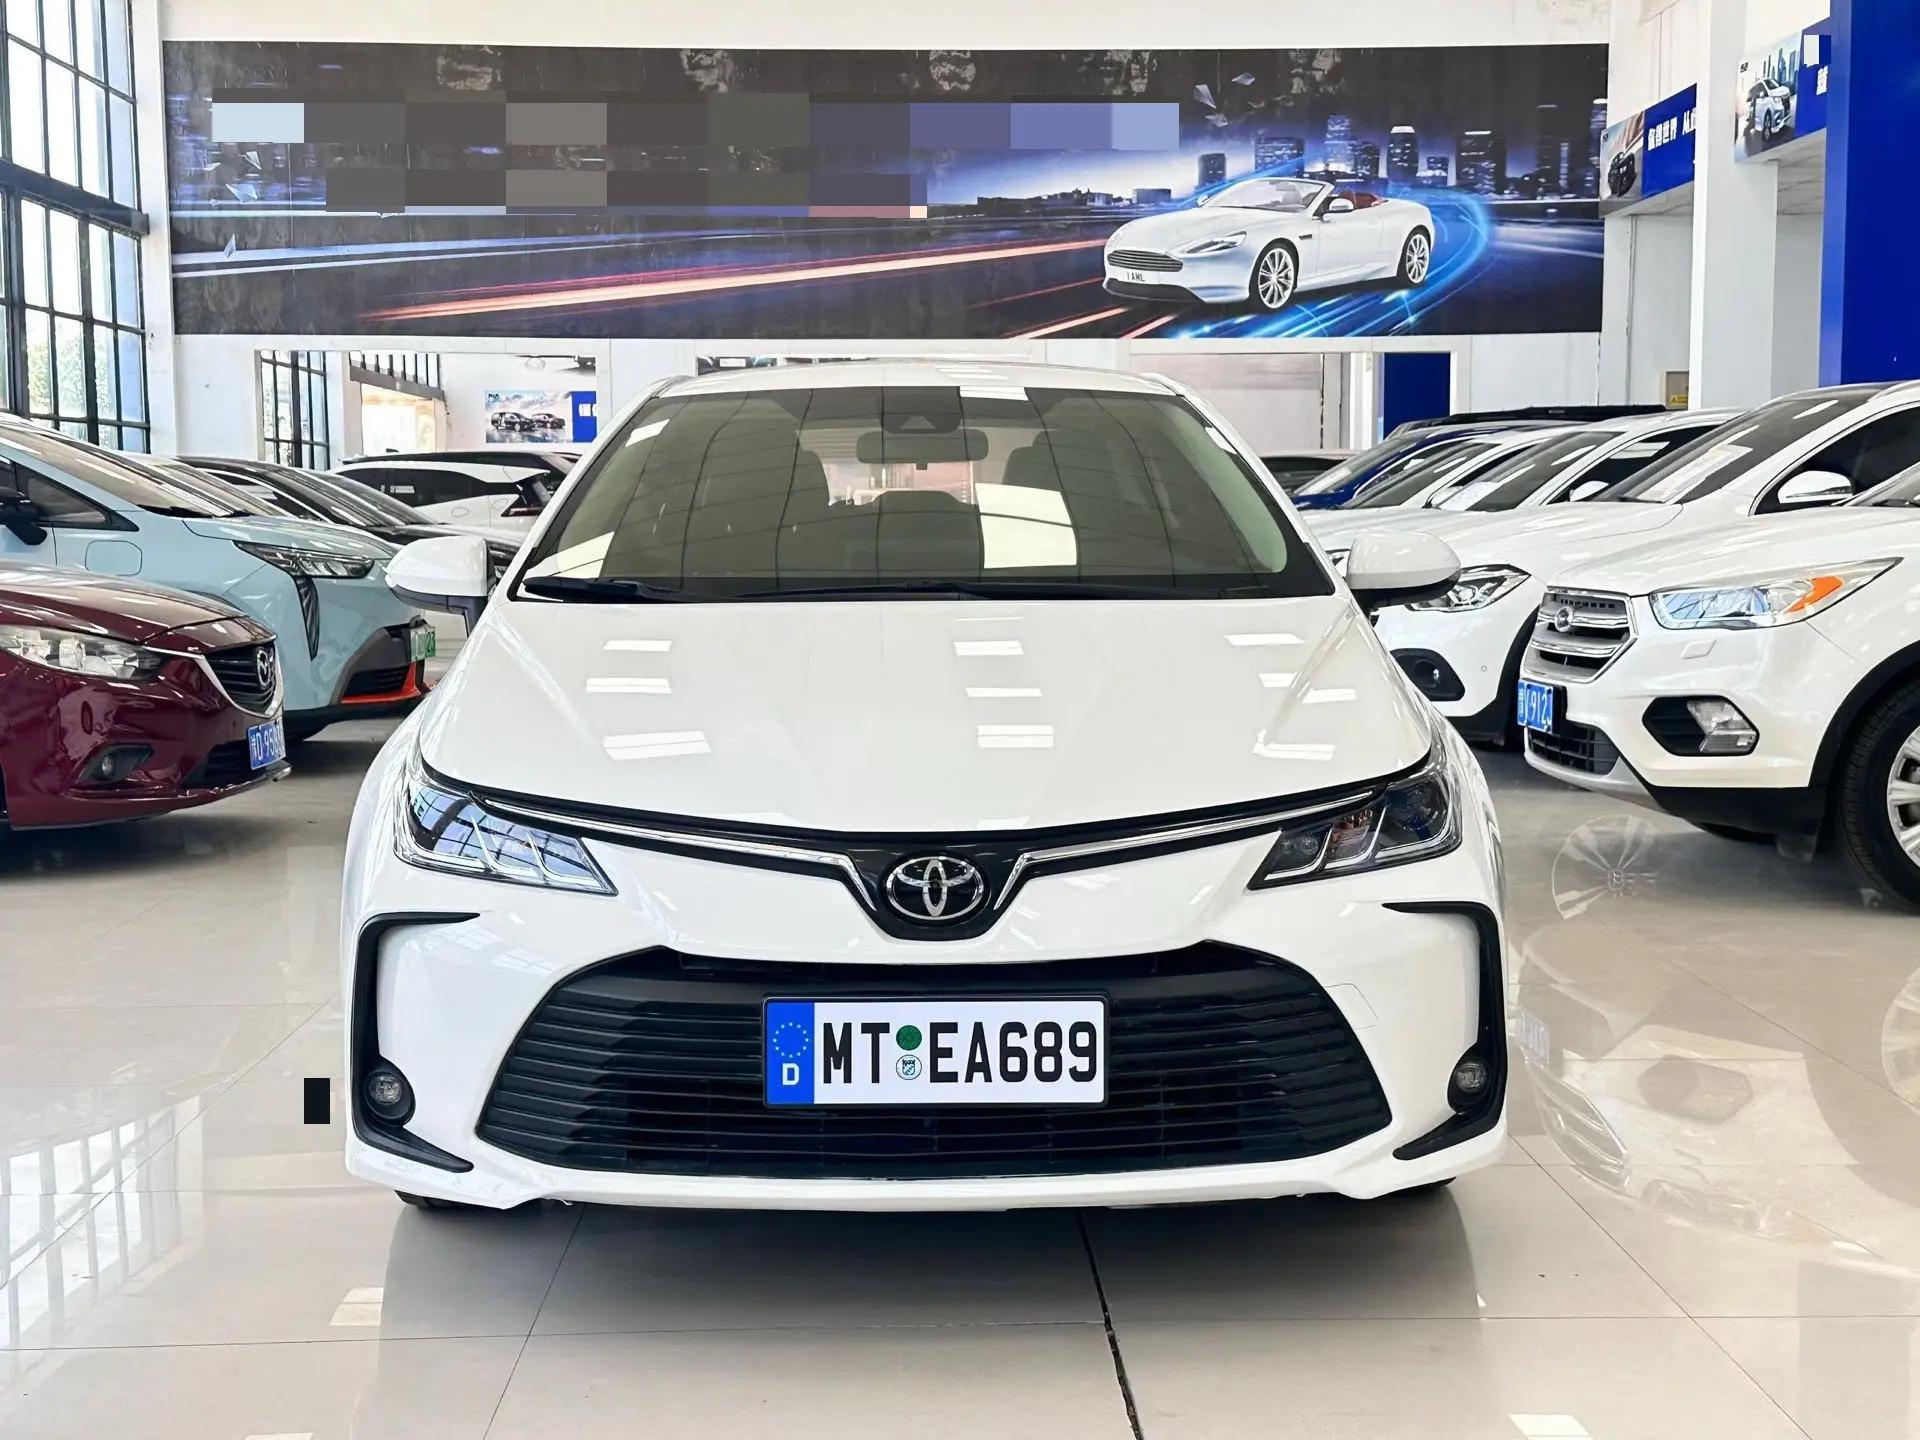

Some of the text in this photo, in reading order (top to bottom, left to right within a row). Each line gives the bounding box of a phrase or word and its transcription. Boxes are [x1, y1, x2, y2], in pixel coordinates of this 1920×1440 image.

[823, 1021, 1097, 1084] MT EA689
[782, 1063, 799, 1086] D
